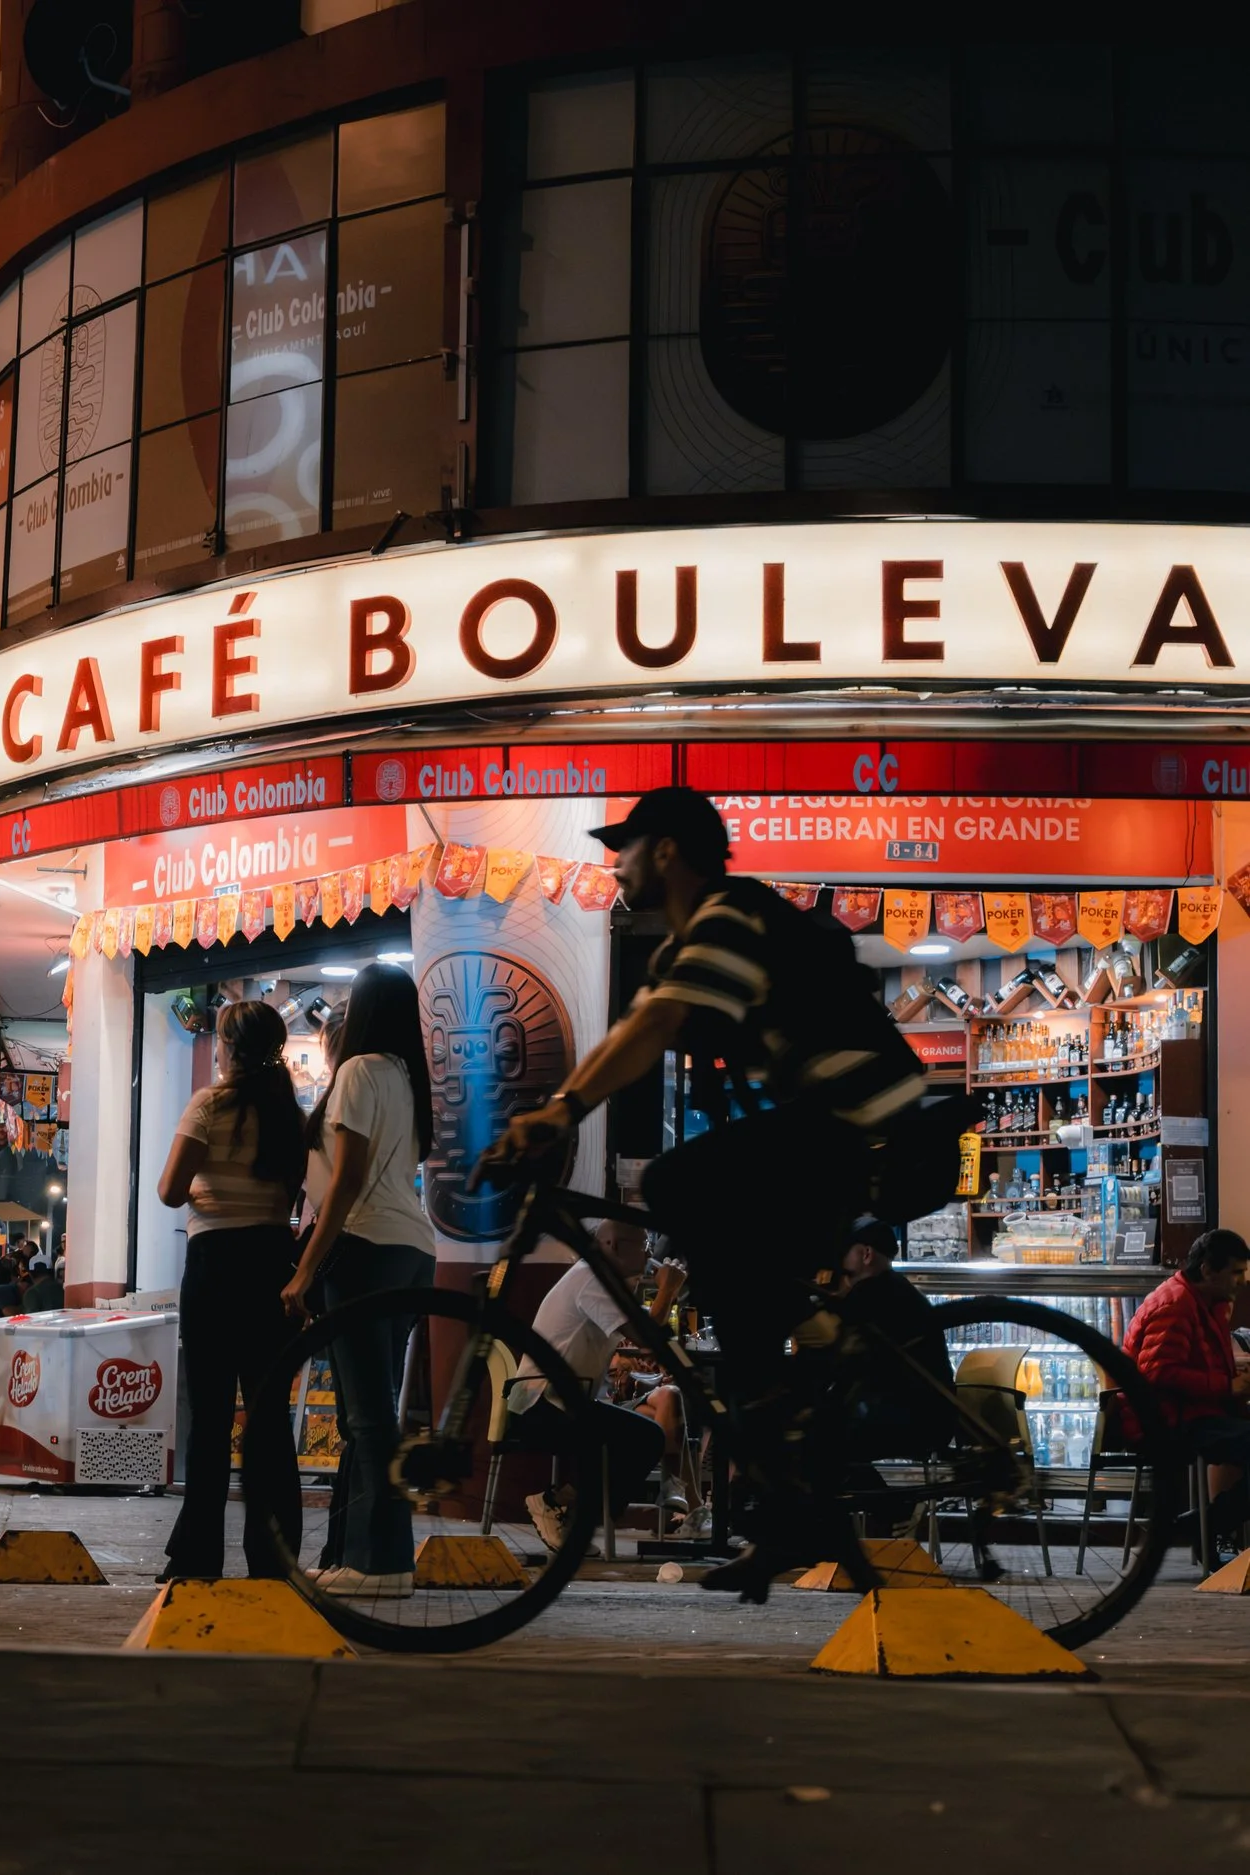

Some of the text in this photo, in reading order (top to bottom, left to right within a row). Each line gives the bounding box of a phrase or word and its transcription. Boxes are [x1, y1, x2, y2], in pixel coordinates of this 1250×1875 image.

[1055, 190, 1234, 287] Cub
[246, 280, 376, 339] Club Colobia
[26, 467, 112, 534] Club Clombia
[1, 559, 1236, 764] CAFÉ BOULEVA
[417, 760, 606, 797] Club Colombia
[853, 753, 899, 792] CC
[188, 770, 326, 818] Club Colombia
[11, 819, 31, 855] CC
[726, 816, 1080, 842] E CELEBRAN EN GRANDE
[153, 824, 318, 898] Club Colombia
[885, 908, 924, 919] POKER
[987, 908, 1025, 921] POKER
[1080, 906, 1118, 919] POKER
[1180, 903, 1217, 913] POKER
[922, 1045, 963, 1057] GRANDE
[13, 1356, 36, 1378] Crem
[102, 1366, 152, 1389] Crem
[10, 1376, 38, 1404] Helado
[94, 1383, 157, 1414] Helado
